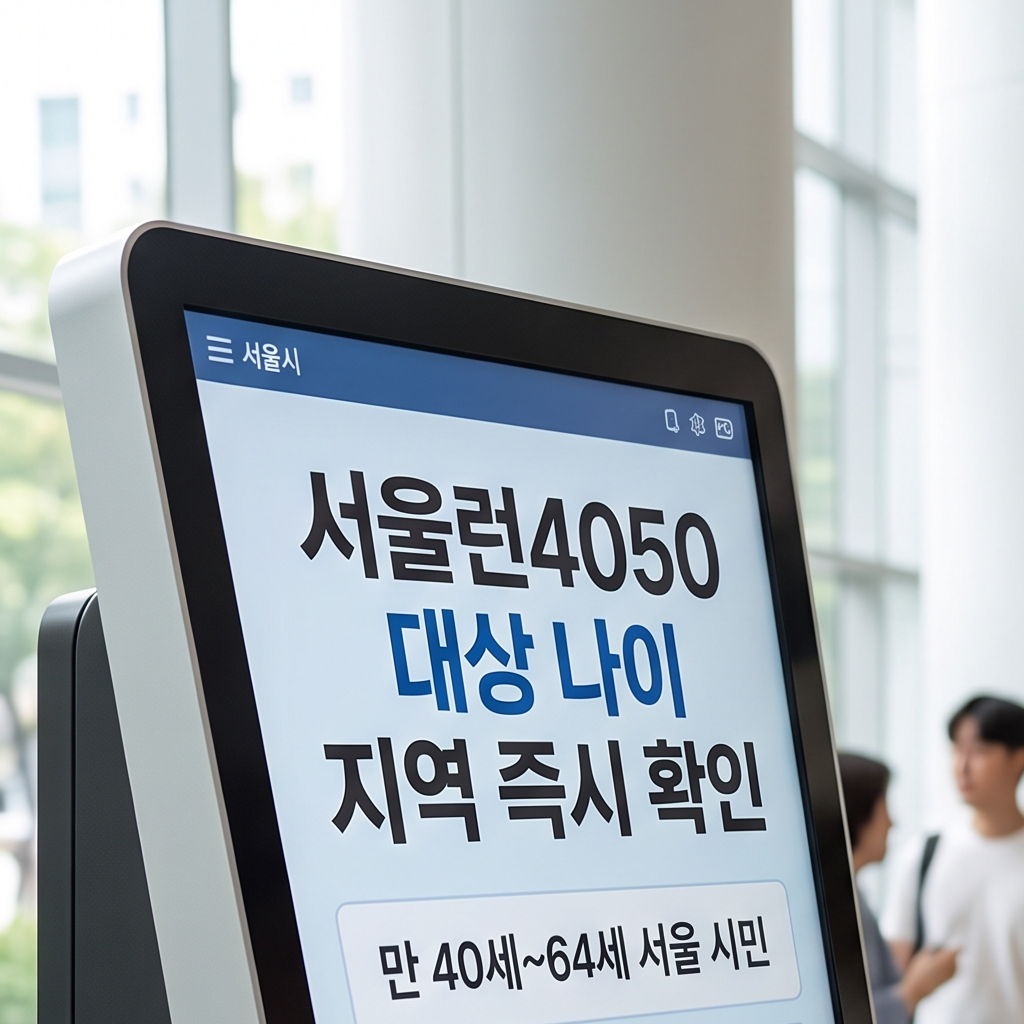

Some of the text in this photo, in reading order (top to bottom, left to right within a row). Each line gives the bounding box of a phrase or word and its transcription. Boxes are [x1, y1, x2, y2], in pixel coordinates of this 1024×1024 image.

[243, 342, 300, 376] 서울시
[300, 470, 720, 600] 서울런4050
[386, 608, 687, 719] 대상 나이
[323, 736, 767, 845] 지역 즉시 확인
[378, 915, 771, 1001] 만 40세~64세 서울 시민
